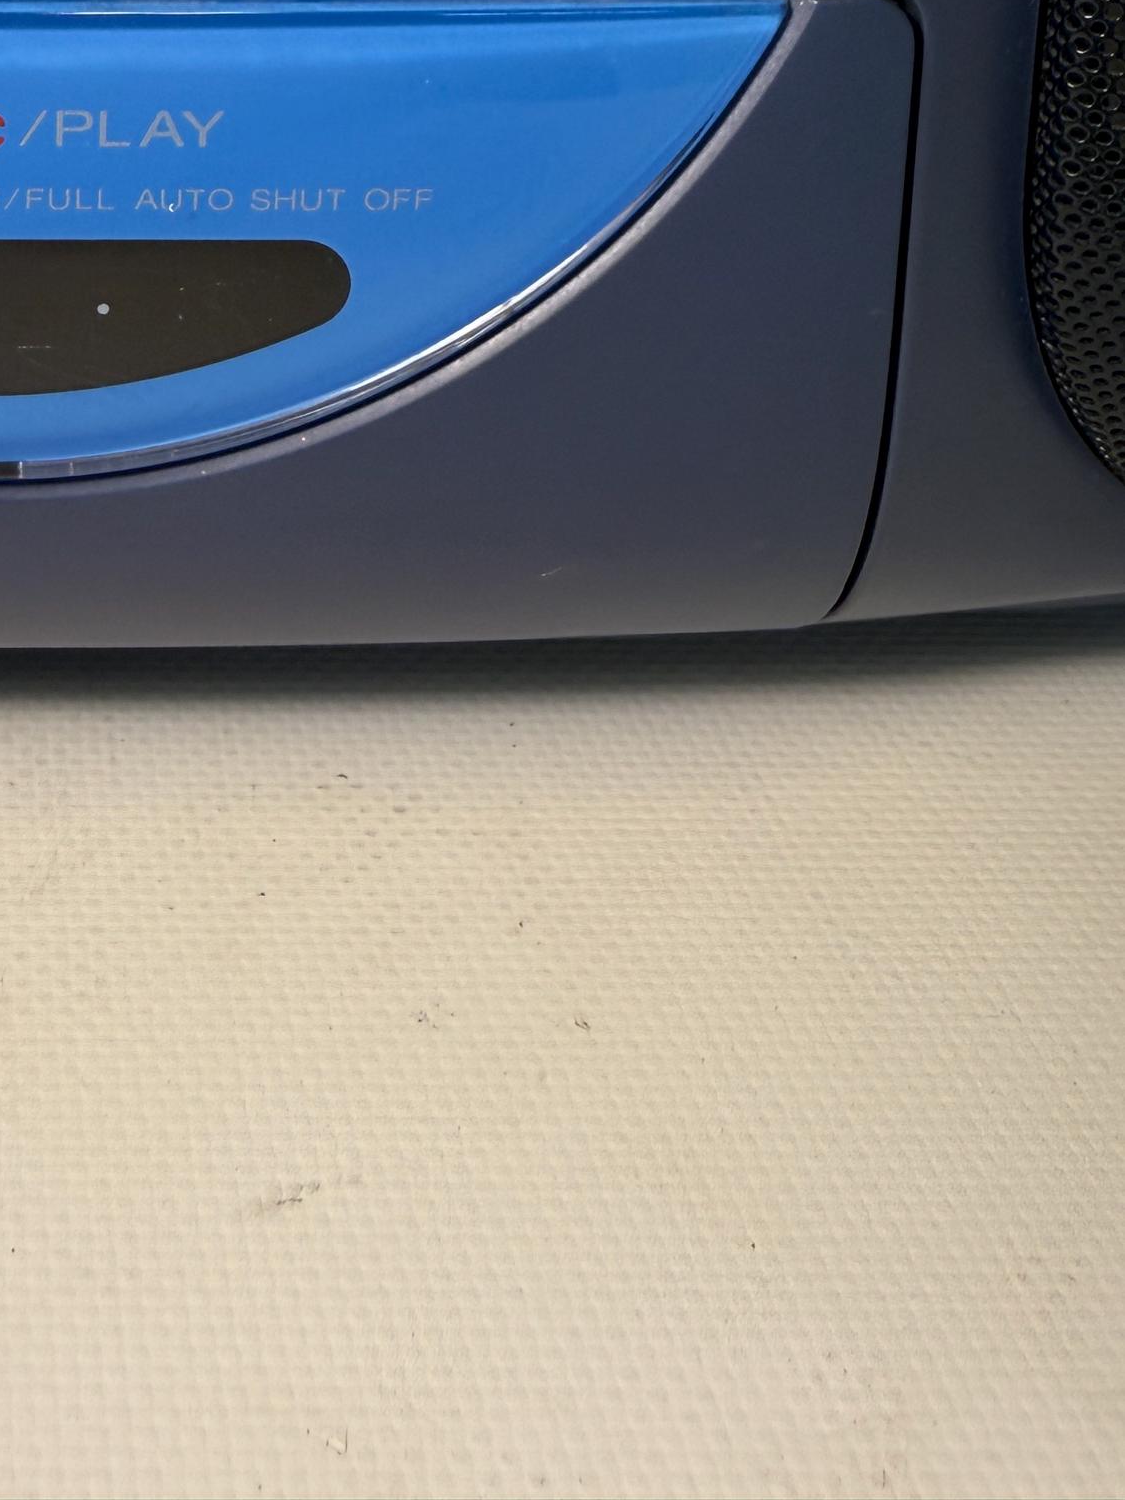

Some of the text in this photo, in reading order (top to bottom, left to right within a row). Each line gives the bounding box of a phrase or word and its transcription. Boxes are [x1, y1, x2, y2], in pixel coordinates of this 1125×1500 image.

[134, 188, 234, 212] AUTO
[250, 188, 346, 212] SHUT
[363, 188, 434, 212] OFF
